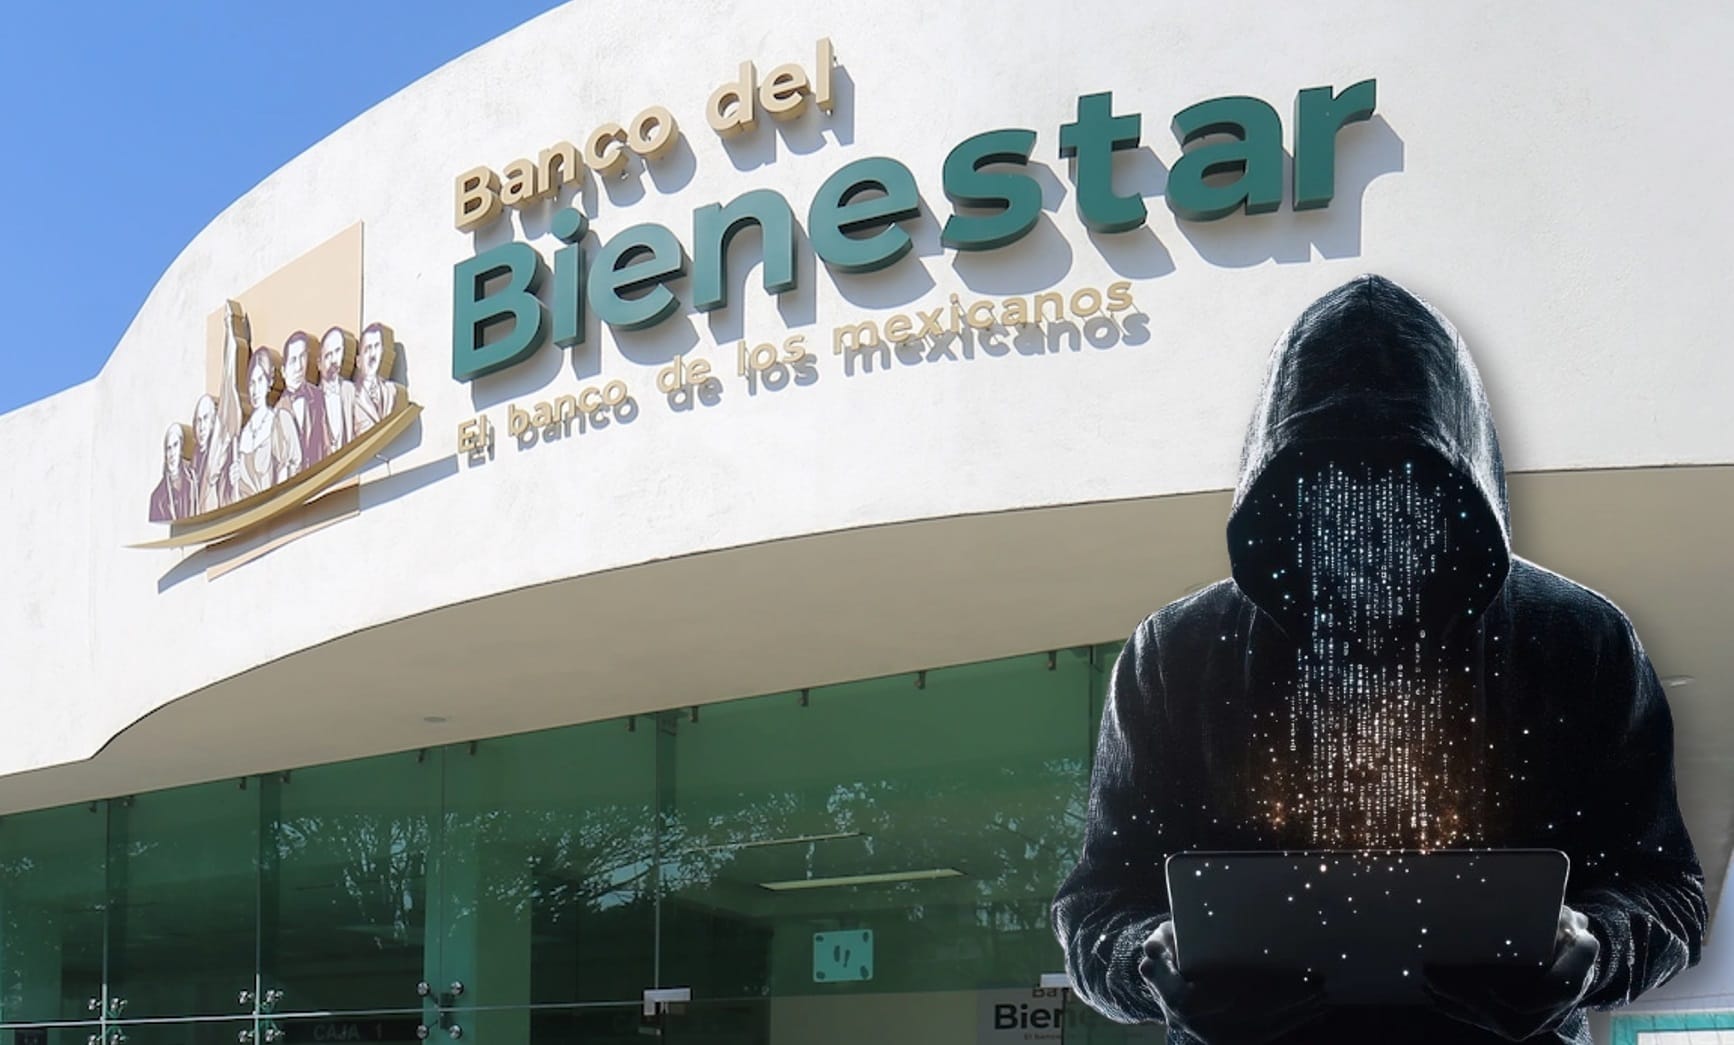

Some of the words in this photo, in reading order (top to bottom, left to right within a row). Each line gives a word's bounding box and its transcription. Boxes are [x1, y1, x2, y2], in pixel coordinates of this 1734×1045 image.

[455, 105, 678, 231] Banco
[706, 37, 835, 139] del
[453, 78, 1377, 384] Bienestar
[457, 414, 488, 454] El
[508, 379, 628, 437] banco
[656, 354, 712, 394] de
[737, 335, 807, 376] los
[833, 281, 1133, 354] mexicanos
[313, 1024, 360, 1041] CAJA
